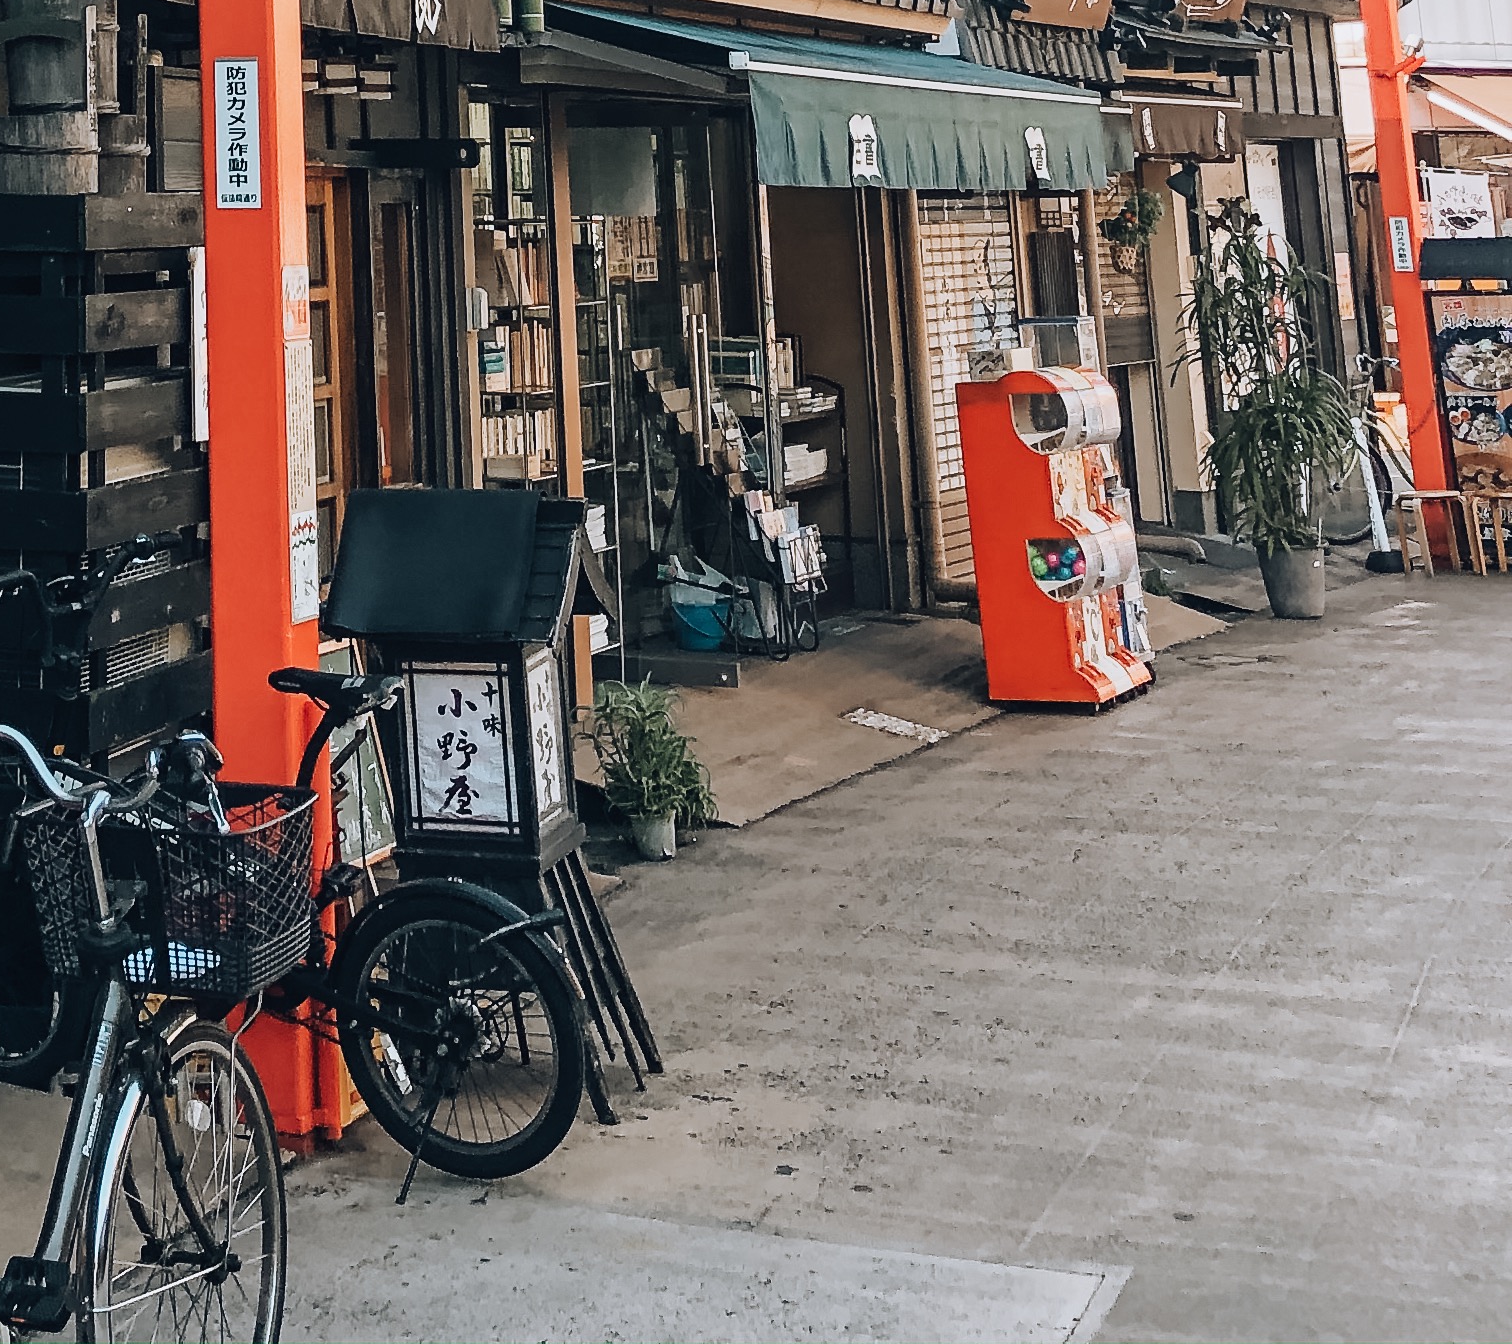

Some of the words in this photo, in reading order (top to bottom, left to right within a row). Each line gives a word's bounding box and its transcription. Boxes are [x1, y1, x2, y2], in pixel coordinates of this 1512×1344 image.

[227, 66, 248, 187] 防犯カメラ作動中
[437, 688, 479, 815] 小野屋
[481, 682, 502, 737] 十味
